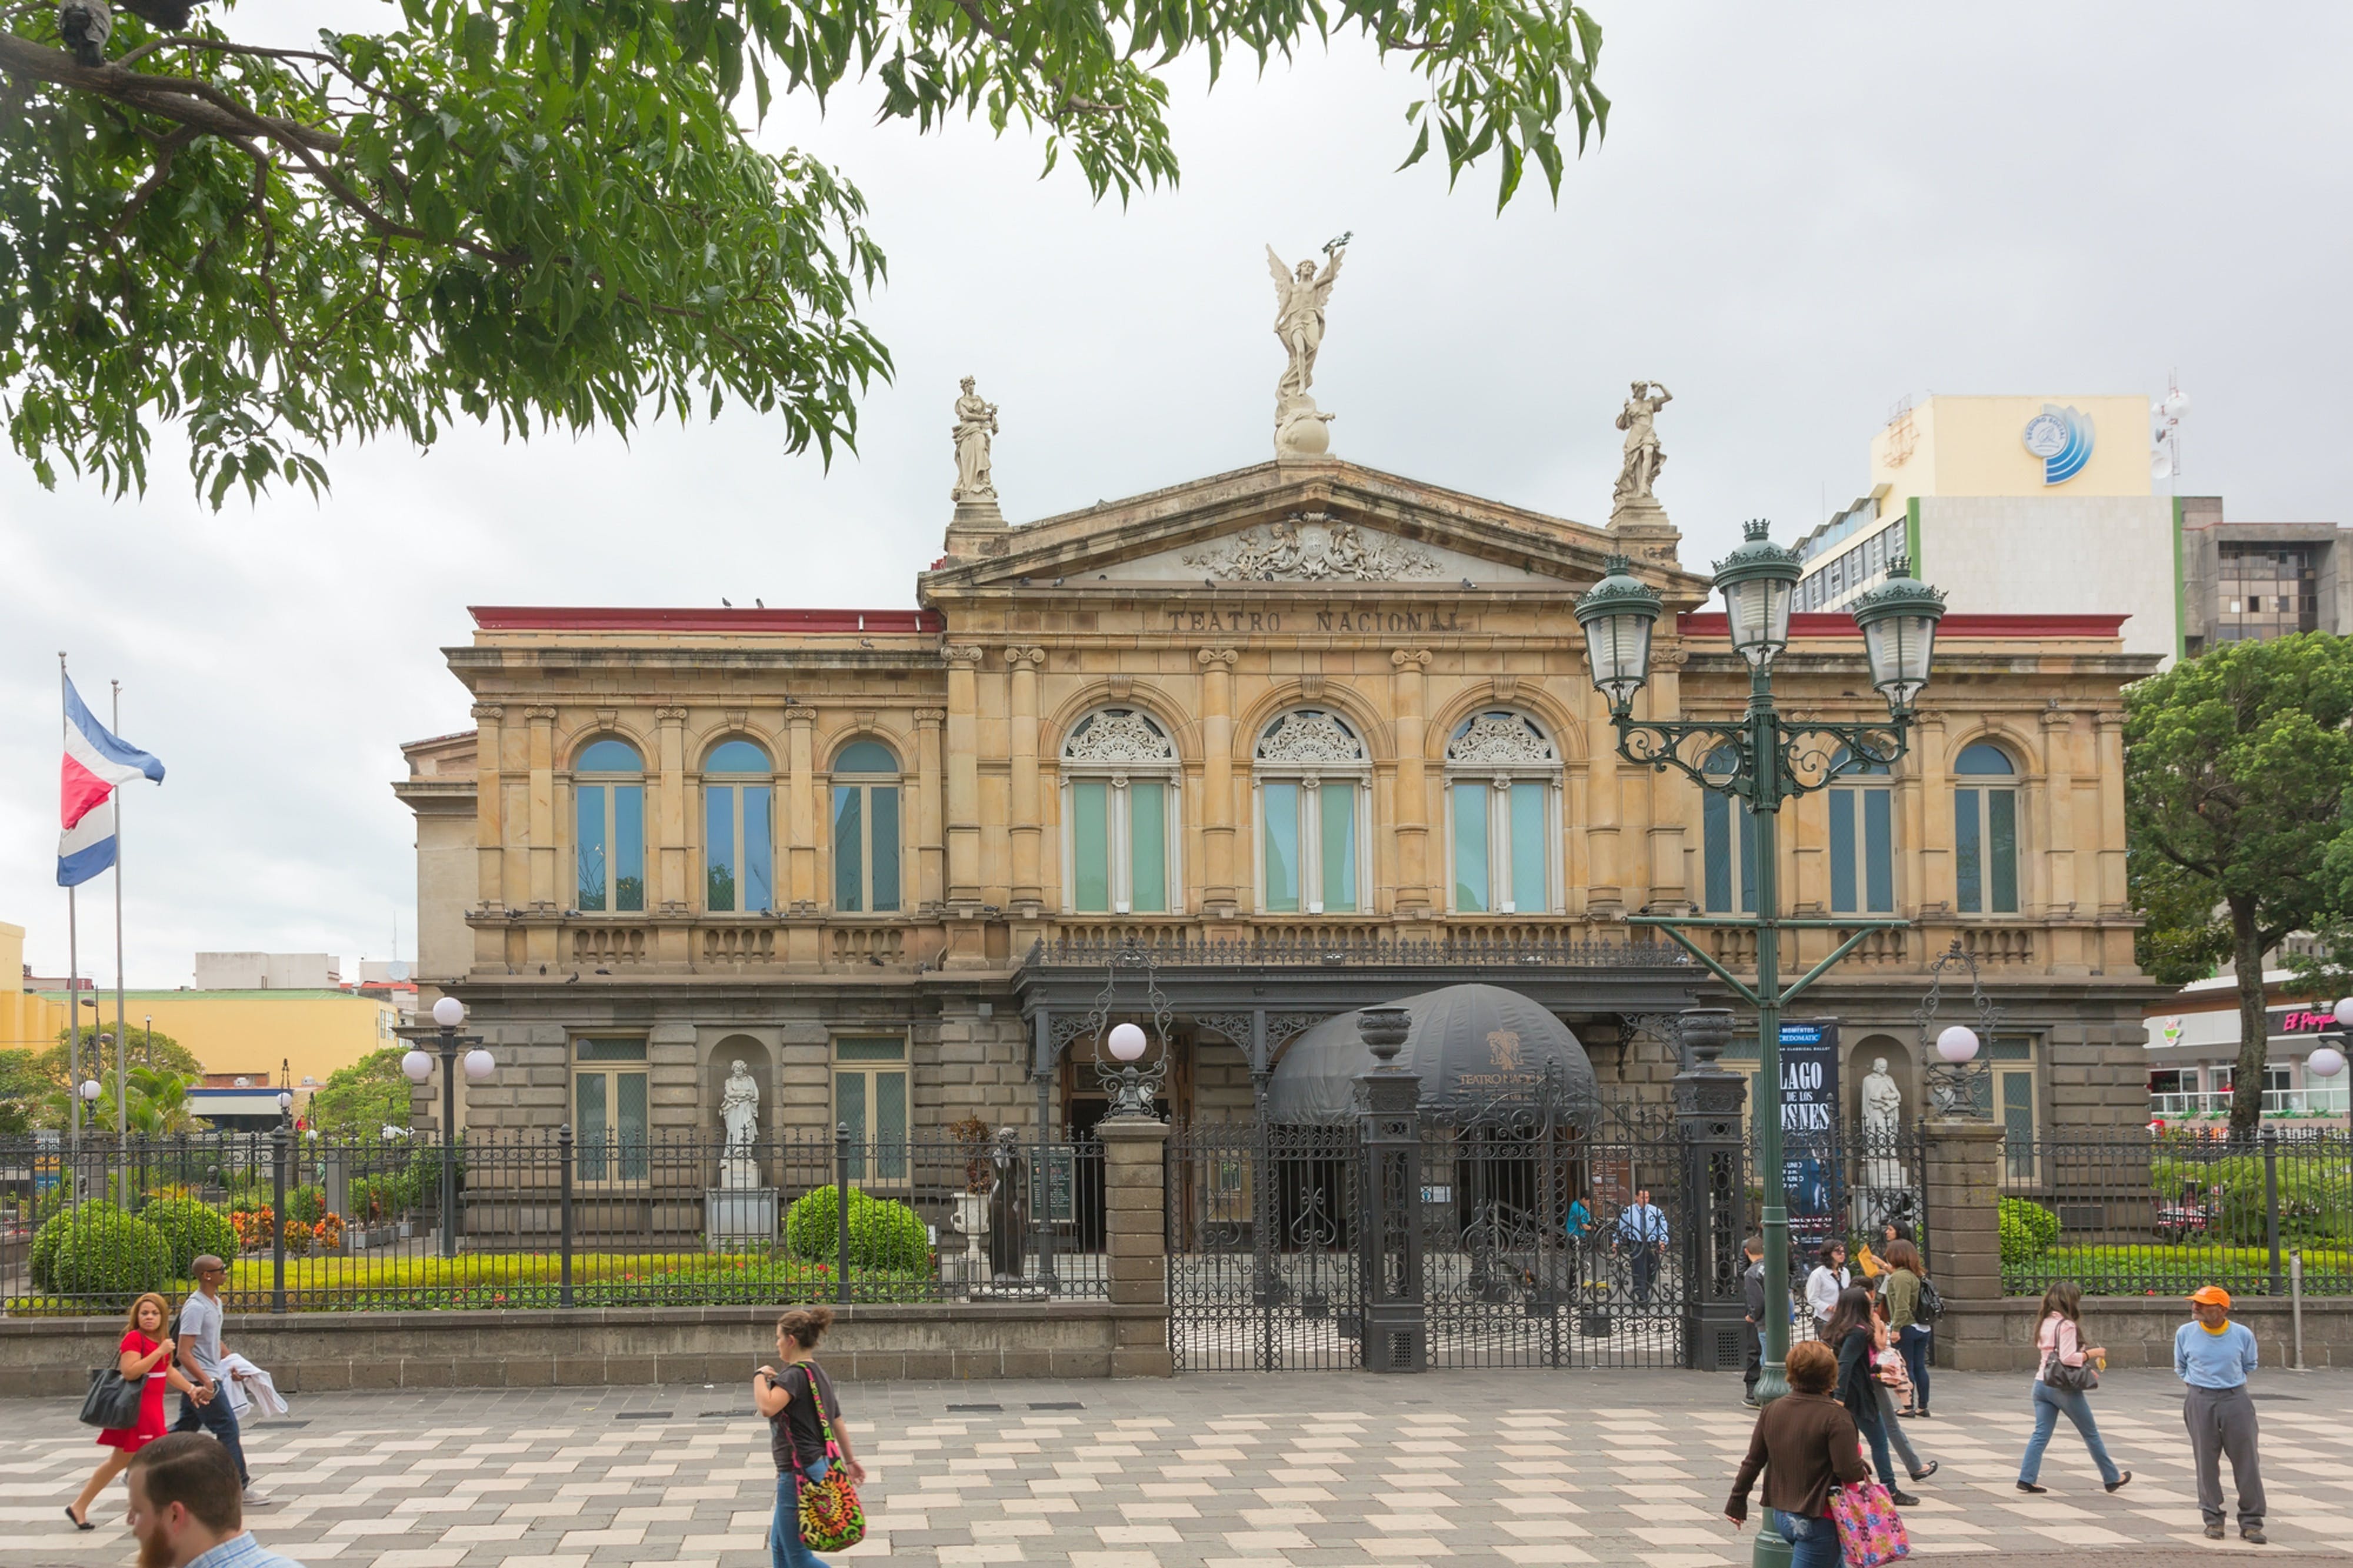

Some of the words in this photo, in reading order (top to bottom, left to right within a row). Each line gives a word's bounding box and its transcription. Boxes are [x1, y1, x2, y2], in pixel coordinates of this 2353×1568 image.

[1168, 611, 1281, 631] TEATRO
[1316, 612, 1464, 632] NACIONAL
[2284, 1013, 2298, 1031] El
[1459, 1073, 1501, 1085] TEATRO
[1779, 1062, 1822, 1090] LAGO
[1787, 1092, 1797, 1102] DE
[1800, 1092, 1813, 1102] LOS
[1781, 1103, 1829, 1130] ISNES
